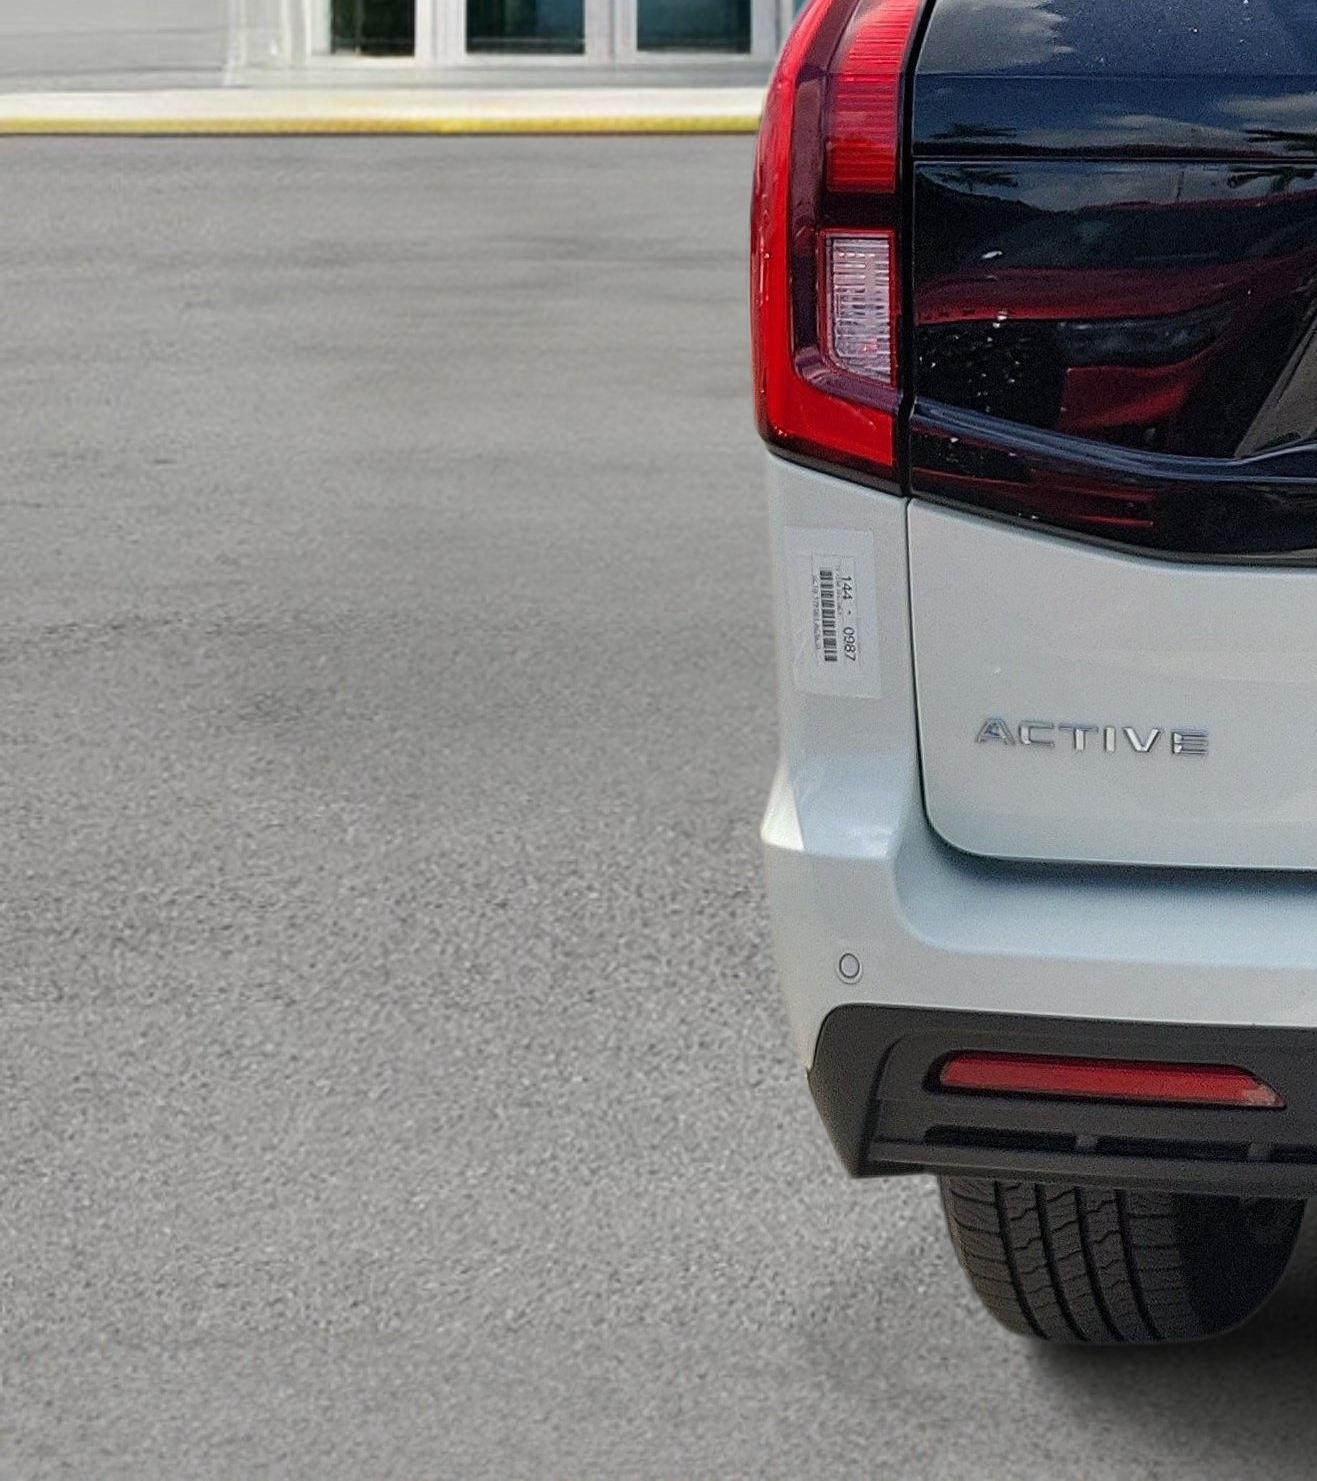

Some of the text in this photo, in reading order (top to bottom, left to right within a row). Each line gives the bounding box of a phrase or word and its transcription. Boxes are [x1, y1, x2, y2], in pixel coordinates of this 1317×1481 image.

[841, 575, 853, 600] 144
[843, 626, 856, 662] 0987
[974, 716, 1208, 756] ACTIVE
